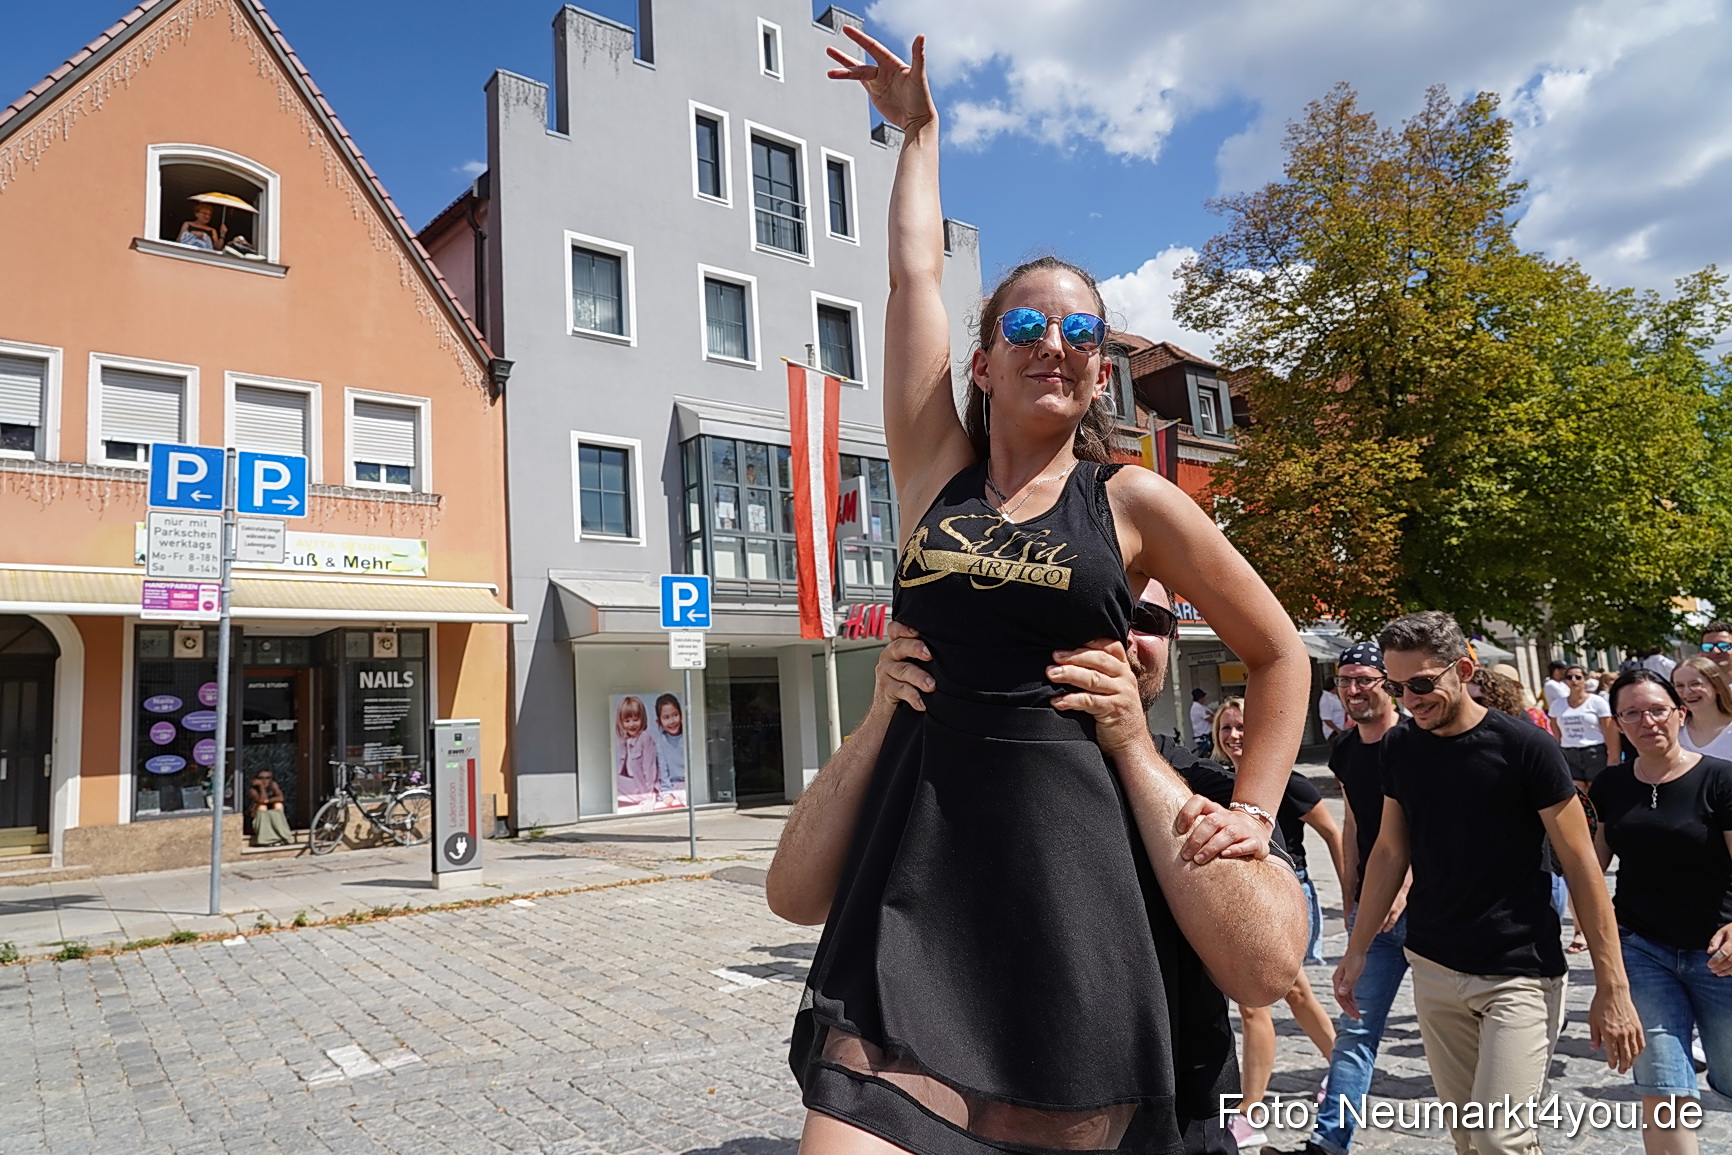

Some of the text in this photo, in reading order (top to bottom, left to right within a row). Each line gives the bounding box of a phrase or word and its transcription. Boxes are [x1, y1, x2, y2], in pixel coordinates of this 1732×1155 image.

[167, 452, 208, 500] P
[253, 460, 291, 507] P
[164, 518, 208, 528] nur mit
[154, 527, 217, 539] Parkschein
[159, 539, 212, 550] werktags
[152, 562, 165, 571] Sa
[325, 557, 336, 568] &
[343, 555, 392, 570] Mehr
[968, 558, 1063, 586] ARTICO
[672, 582, 699, 621] P
[844, 603, 886, 640] H&M
[359, 671, 414, 689] NAILS
